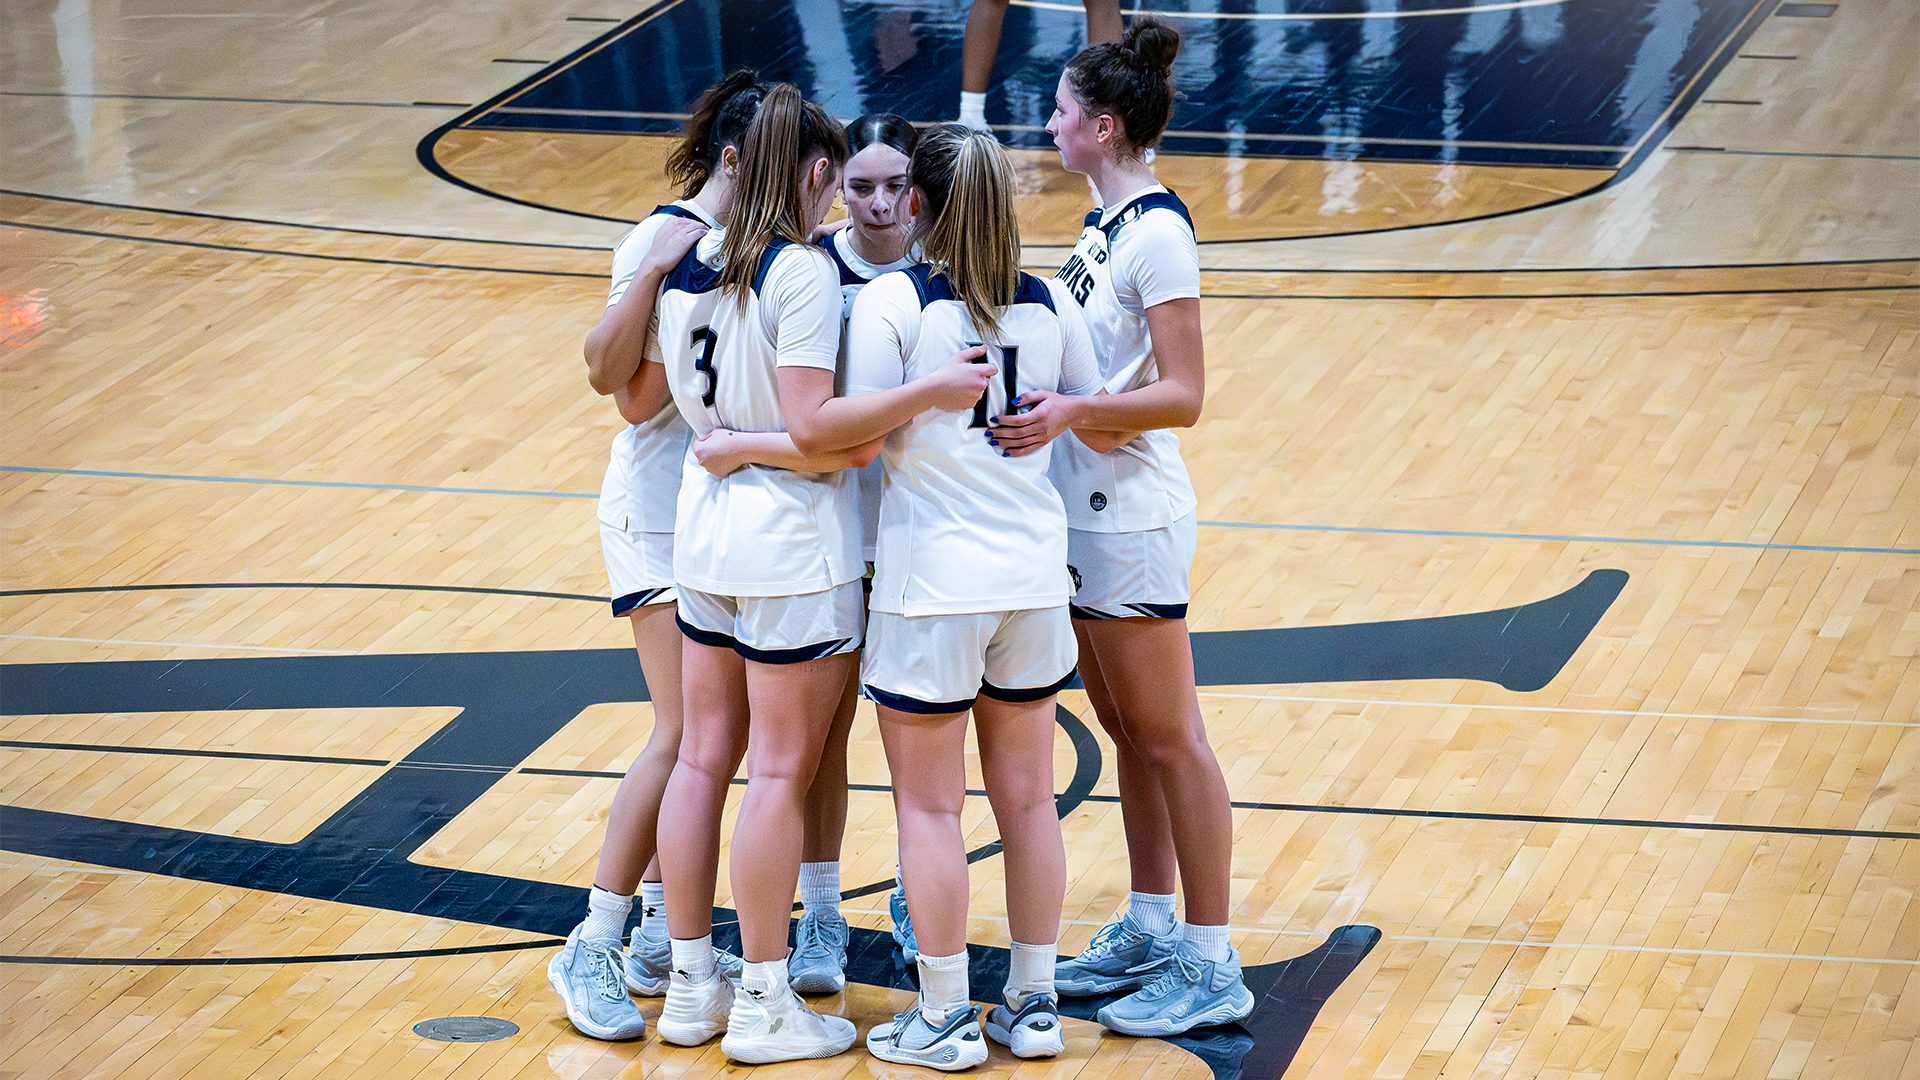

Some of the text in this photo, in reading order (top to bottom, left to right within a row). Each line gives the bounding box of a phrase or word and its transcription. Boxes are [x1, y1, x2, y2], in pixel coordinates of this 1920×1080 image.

[1054, 253, 1095, 308] AWKS
[690, 324, 718, 408] 3
[965, 341, 1021, 429] 11
